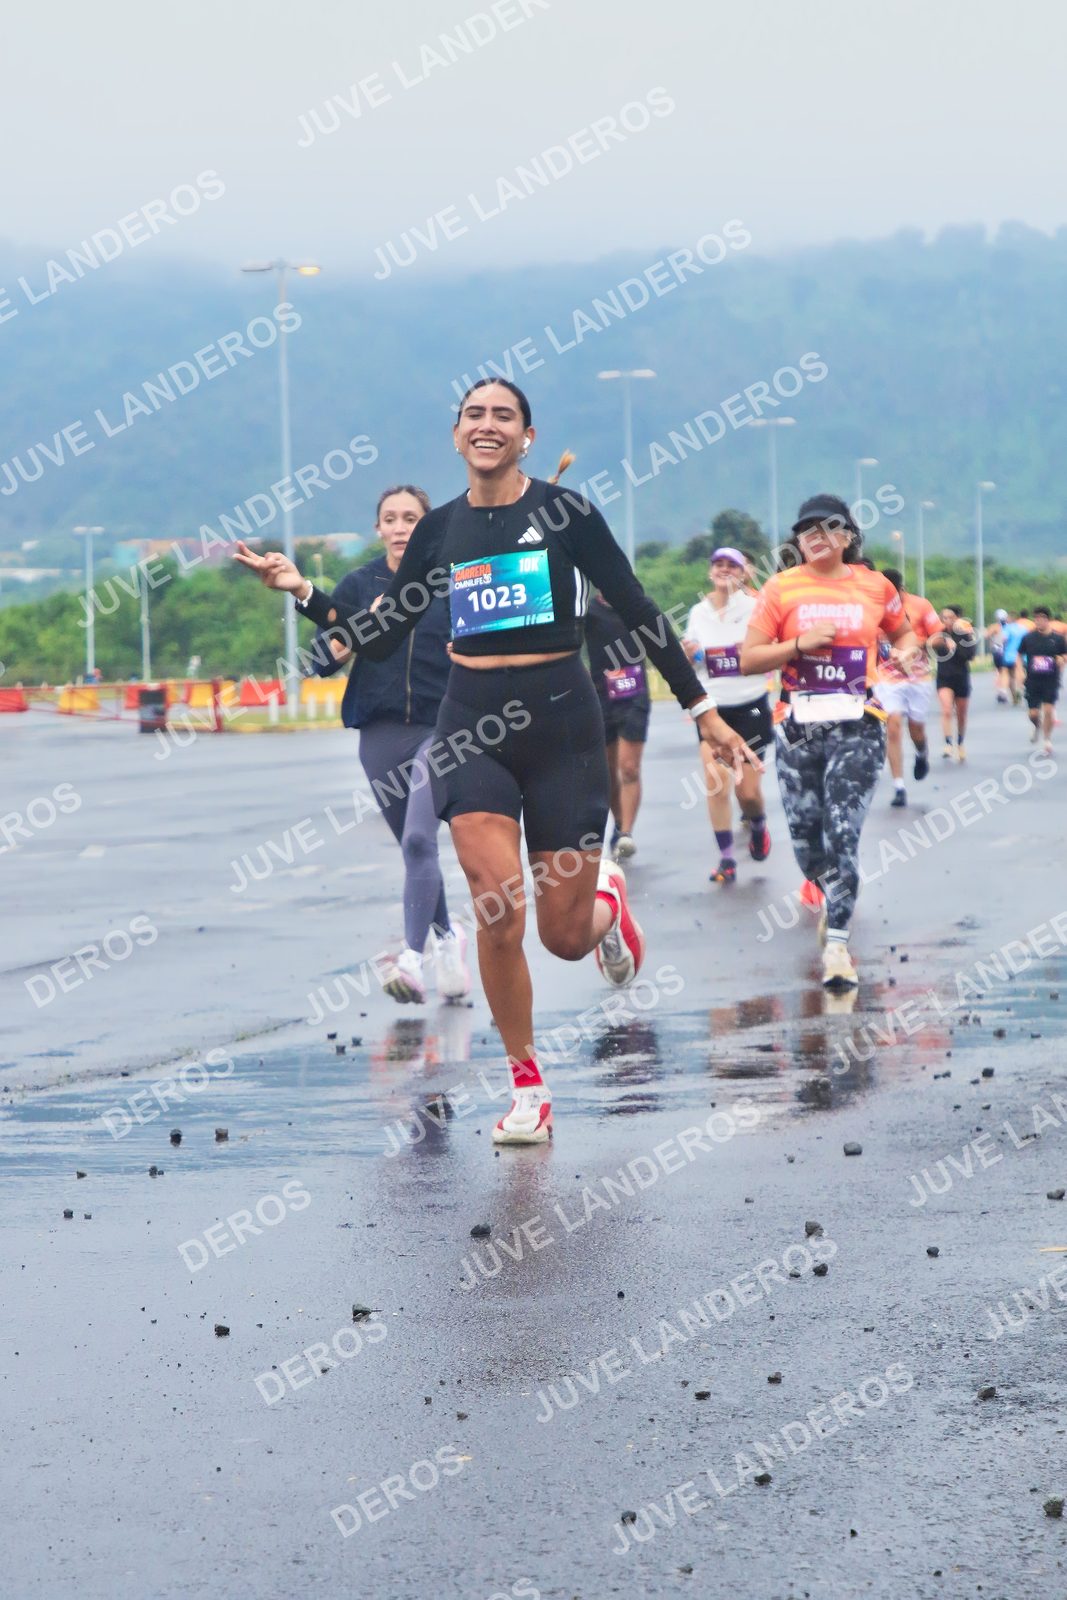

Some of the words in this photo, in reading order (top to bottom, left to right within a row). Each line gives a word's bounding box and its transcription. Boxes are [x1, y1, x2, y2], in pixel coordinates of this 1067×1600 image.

[455, 564, 492, 582] CARRERA
[519, 557, 539, 573] 10K
[467, 583, 527, 613] 1023
[798, 603, 863, 619] CARRERA
[715, 656, 738, 670] 733
[815, 664, 846, 681] 104
